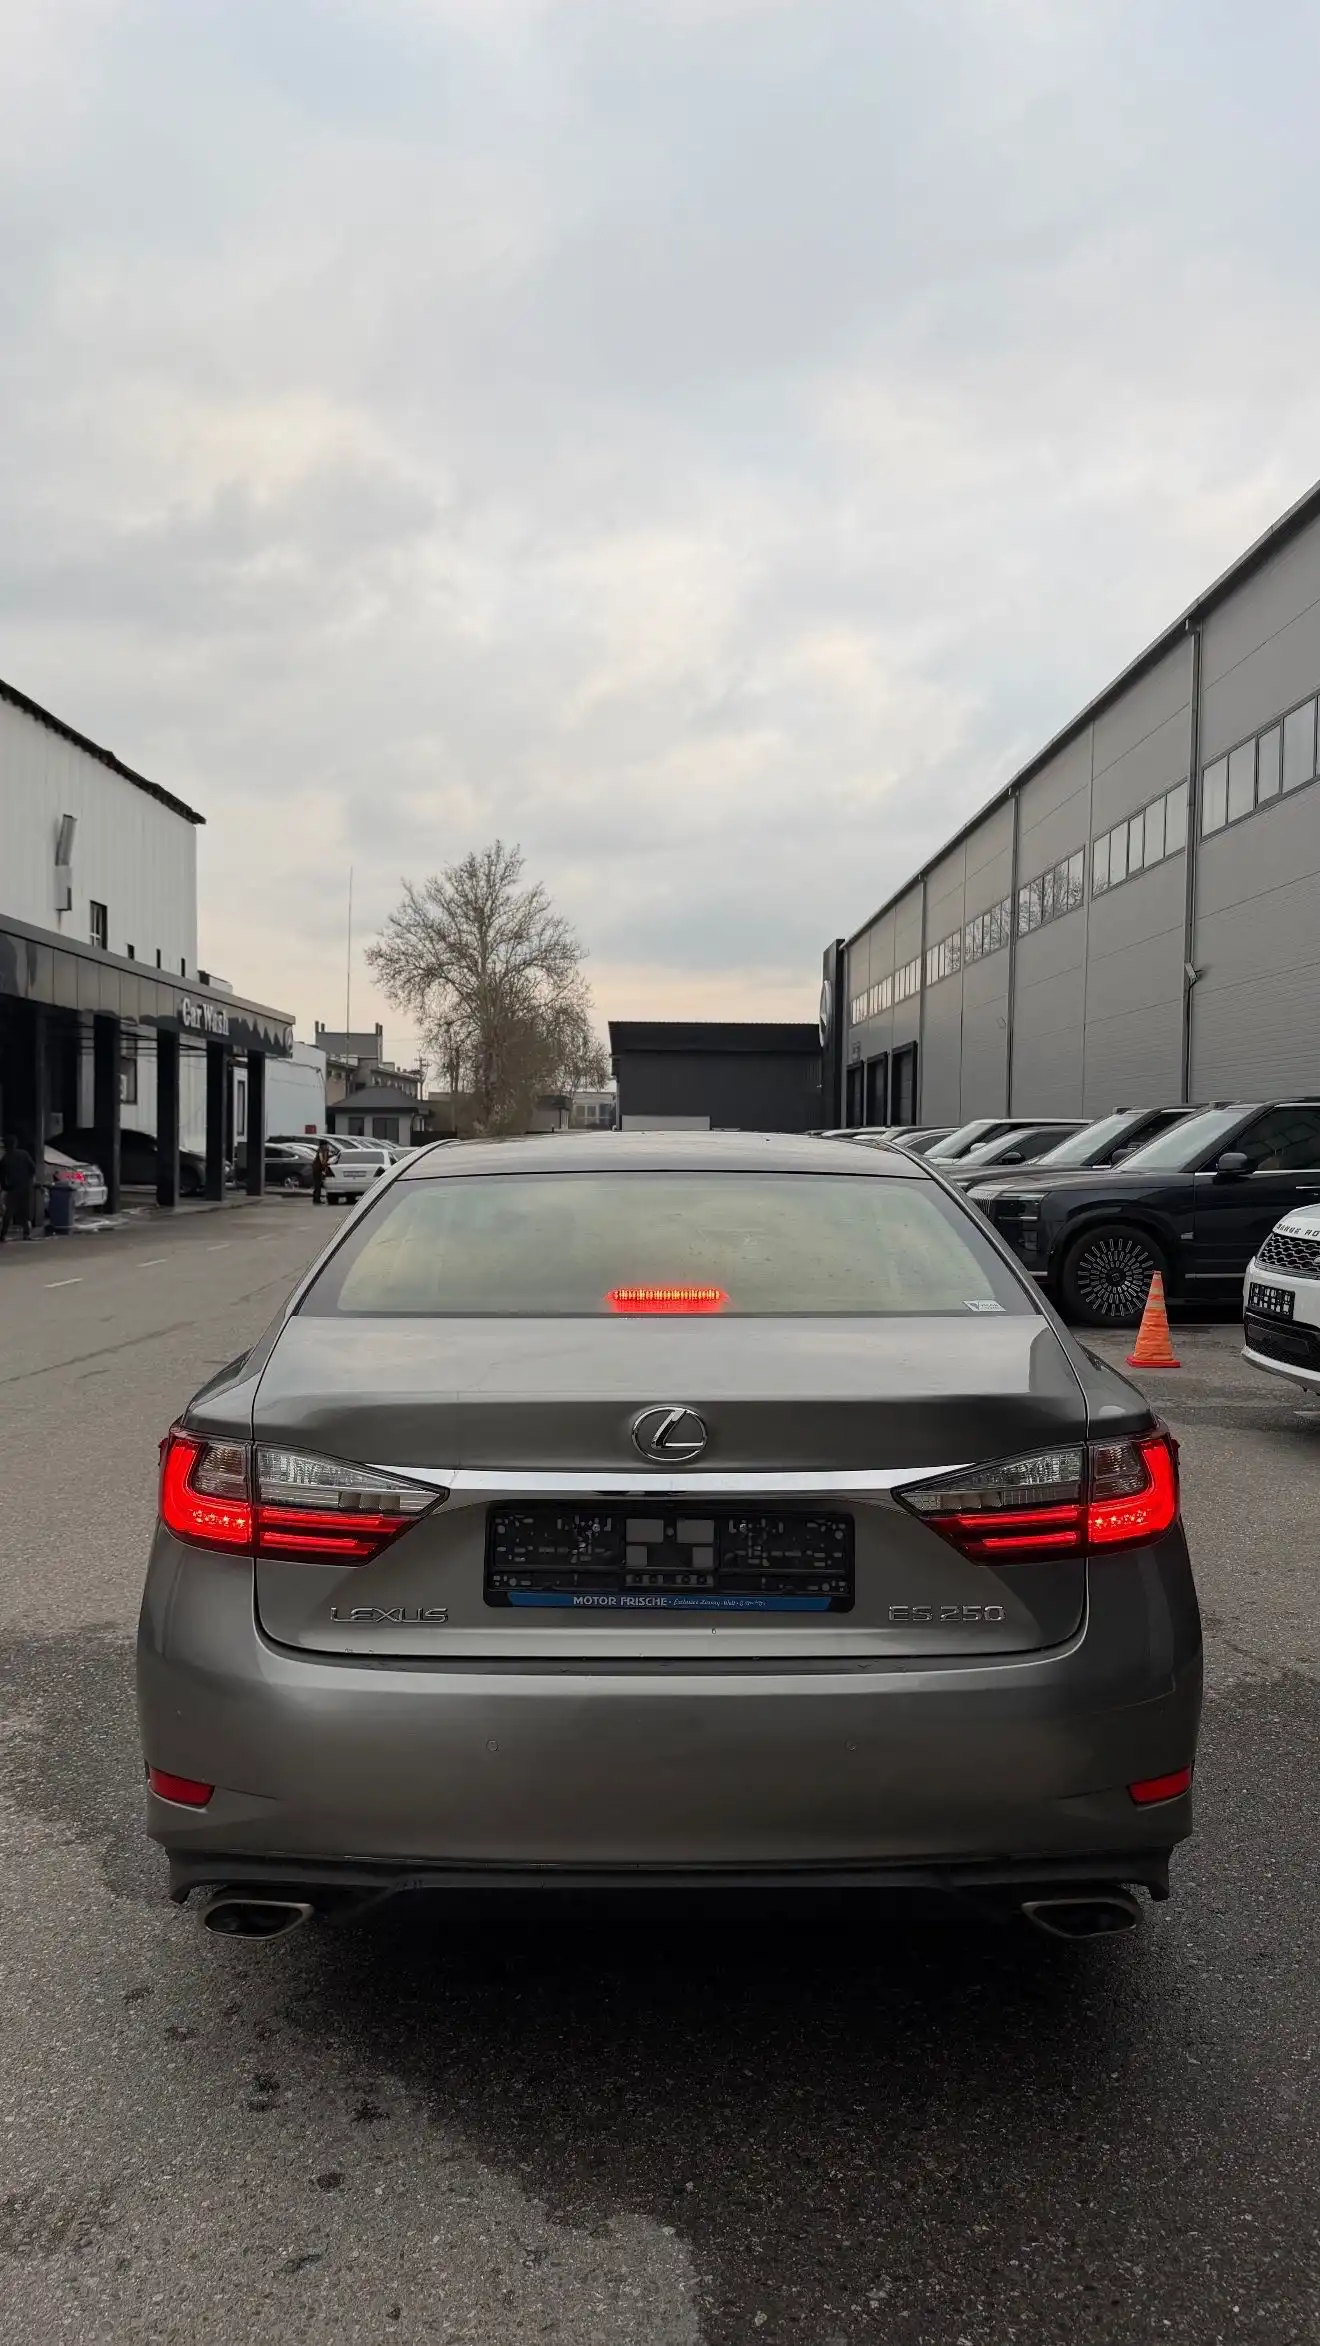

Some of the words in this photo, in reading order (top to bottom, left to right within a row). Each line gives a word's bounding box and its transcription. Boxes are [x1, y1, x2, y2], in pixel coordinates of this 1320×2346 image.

[182, 998, 202, 1029] Car
[203, 1003, 229, 1036] Wash
[573, 1596, 617, 1606] MOTOR
[620, 1596, 668, 1606] FRISCHE
[330, 1607, 448, 1623] LEXUS
[888, 1605, 933, 1621] ES
[940, 1605, 1006, 1621] 250
